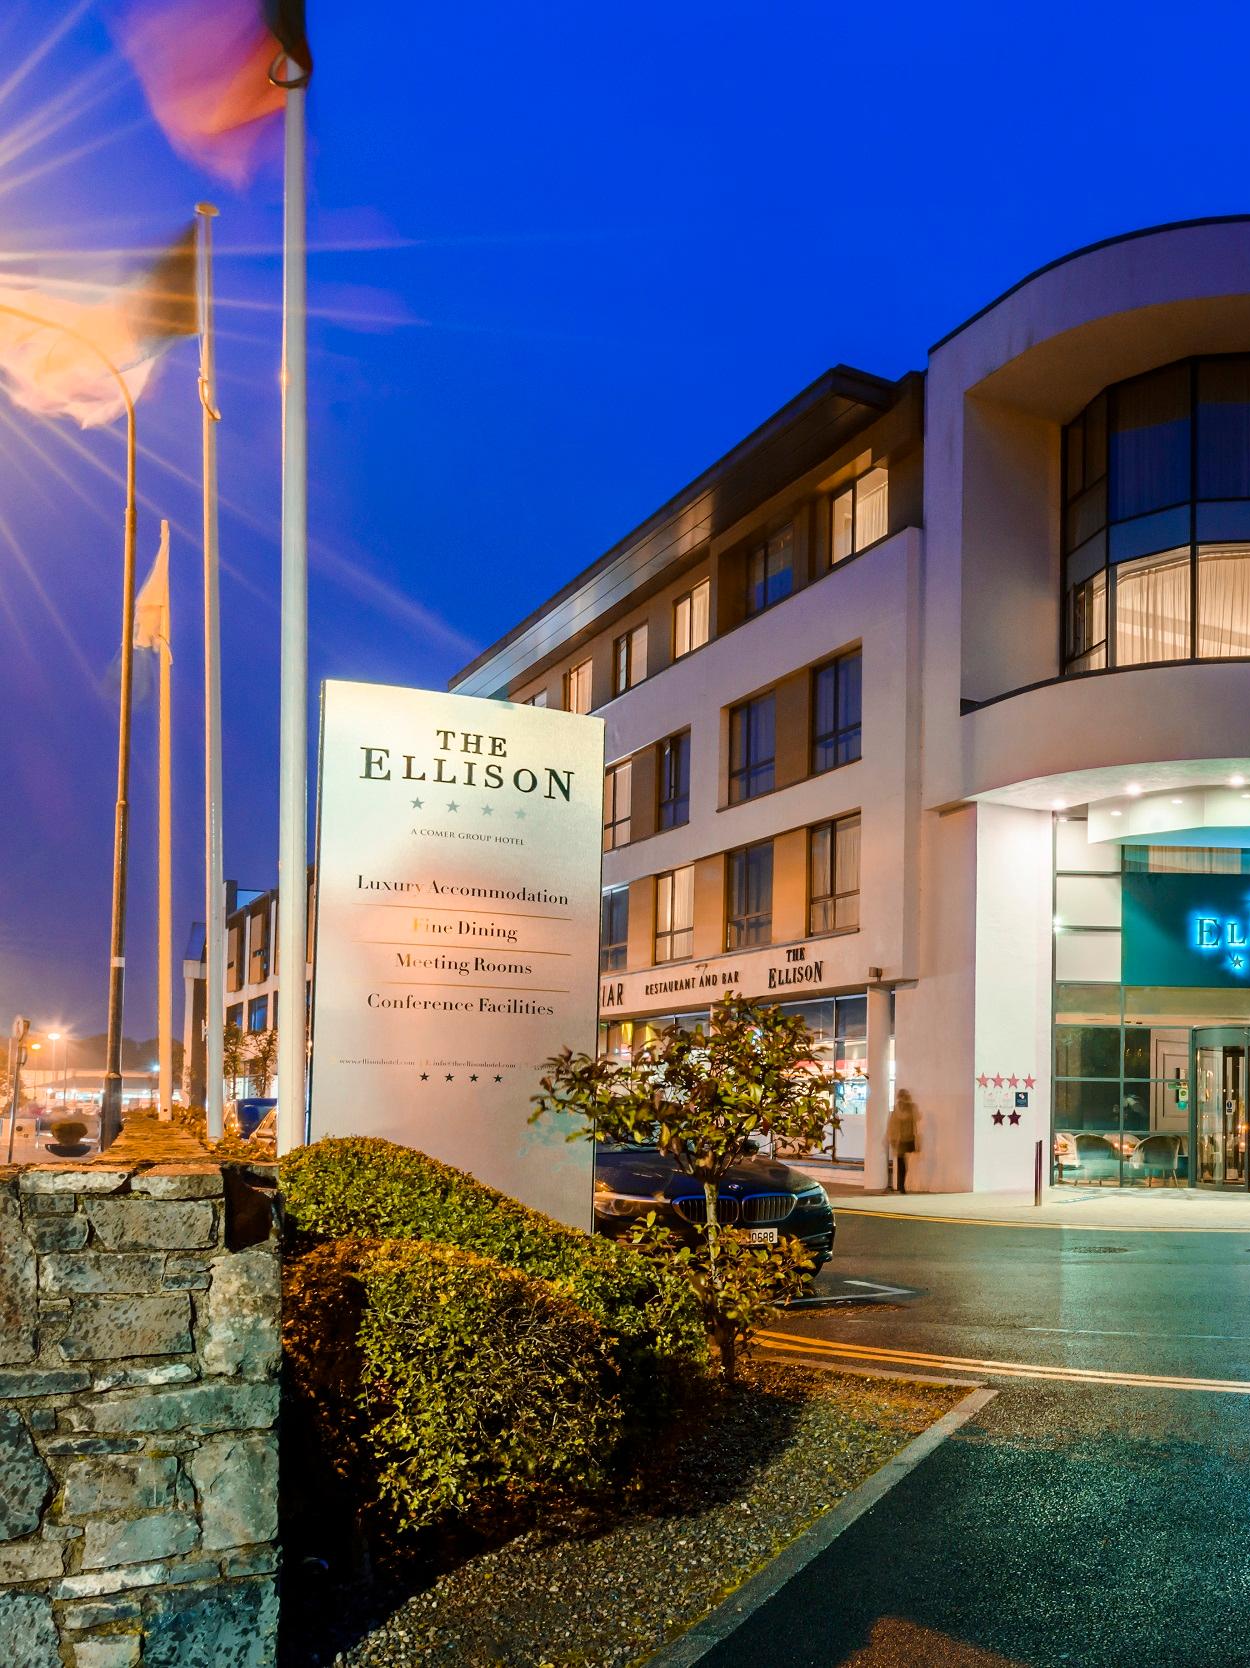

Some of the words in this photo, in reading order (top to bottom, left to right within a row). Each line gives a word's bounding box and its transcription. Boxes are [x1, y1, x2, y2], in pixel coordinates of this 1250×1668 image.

[436, 729, 508, 758] THE
[359, 746, 575, 802] ELLISON
[420, 828, 455, 839] COMER
[458, 832, 492, 842] GROUP
[495, 836, 525, 846] HOTEL
[358, 875, 424, 897] Luxury
[428, 880, 568, 905] Accommodation
[412, 917, 453, 934] Fine
[458, 920, 518, 943] Dining
[396, 953, 470, 976] Meeting
[474, 957, 533, 975] Rooms
[786, 947, 806, 962] THE
[645, 977, 696, 996] RESTAURANT
[699, 974, 717, 987] AND
[722, 971, 739, 984] BAR
[768, 960, 824, 989] ELLISON
[367, 993, 473, 1012] Conference
[479, 998, 554, 1016] Facilities
